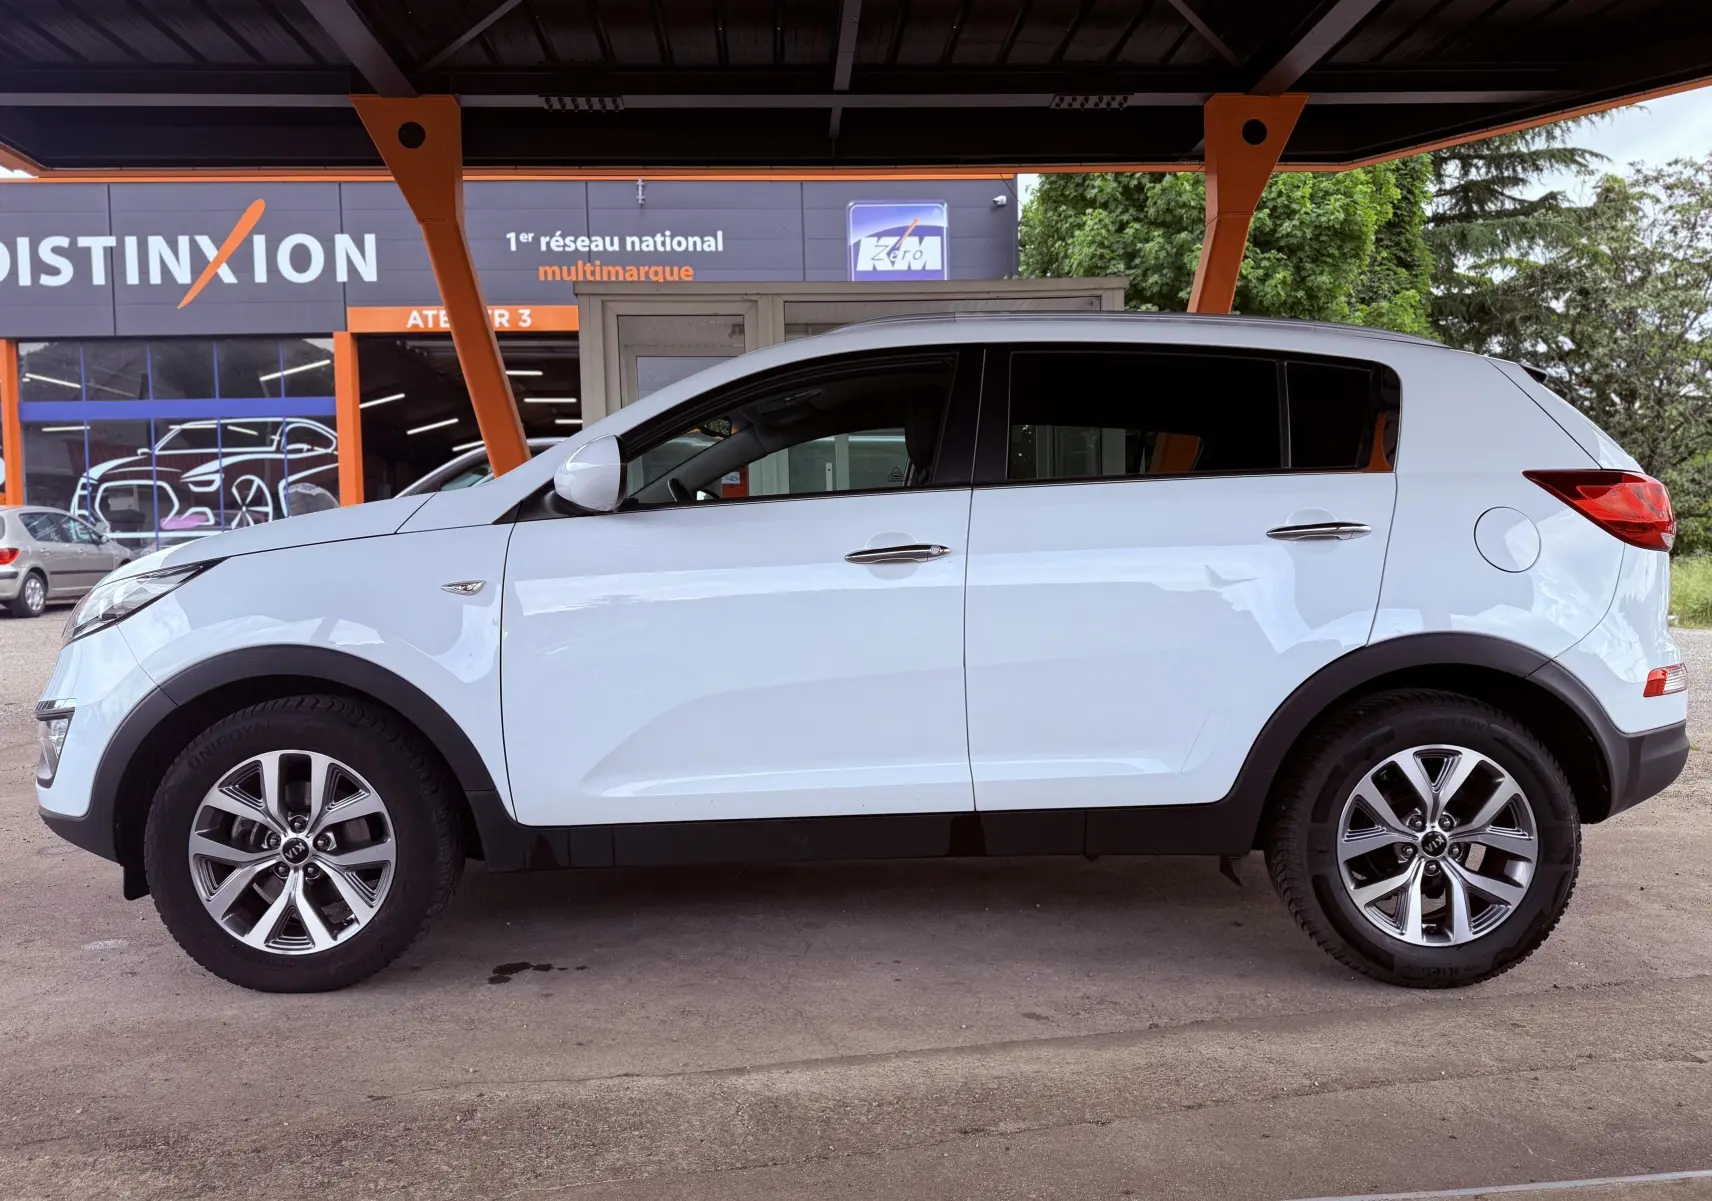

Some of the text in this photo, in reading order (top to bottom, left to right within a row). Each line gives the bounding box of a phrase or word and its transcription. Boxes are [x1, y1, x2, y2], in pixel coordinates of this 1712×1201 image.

[540, 230, 620, 251] réseau
[625, 230, 724, 251] national
[0, 199, 378, 310] ISTINXION
[538, 260, 695, 282] multimarque
[406, 308, 532, 328] ATER 3
[284, 842, 306, 859] KIA
[1424, 835, 1445, 852] KIA
